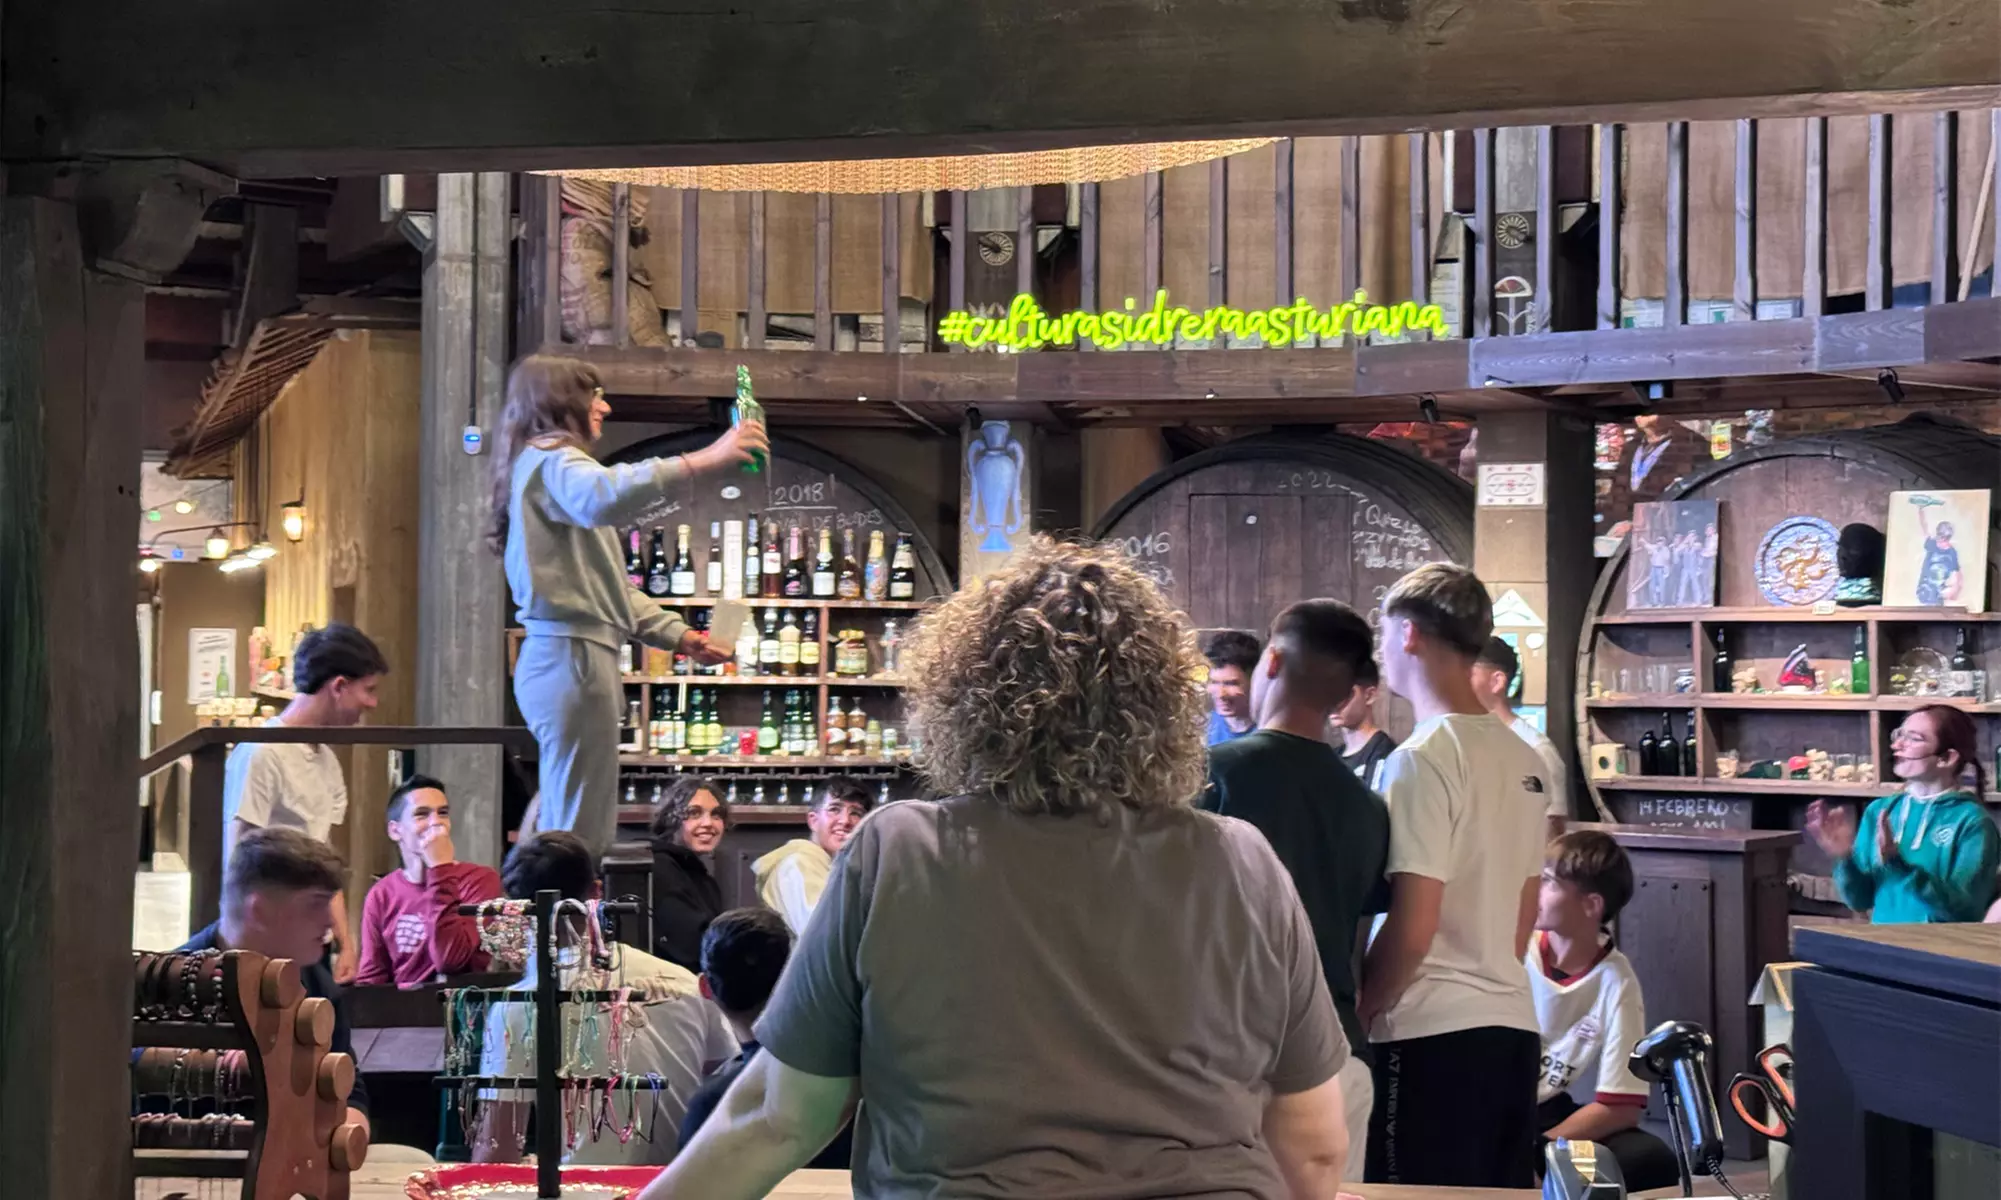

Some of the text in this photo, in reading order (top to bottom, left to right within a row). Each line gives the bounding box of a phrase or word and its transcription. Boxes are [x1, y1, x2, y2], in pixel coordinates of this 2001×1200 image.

[937, 289, 1448, 351] #culturasidreraasturiana
[774, 482, 827, 505] 2018
[1655, 798, 1730, 818] FEBRERO
